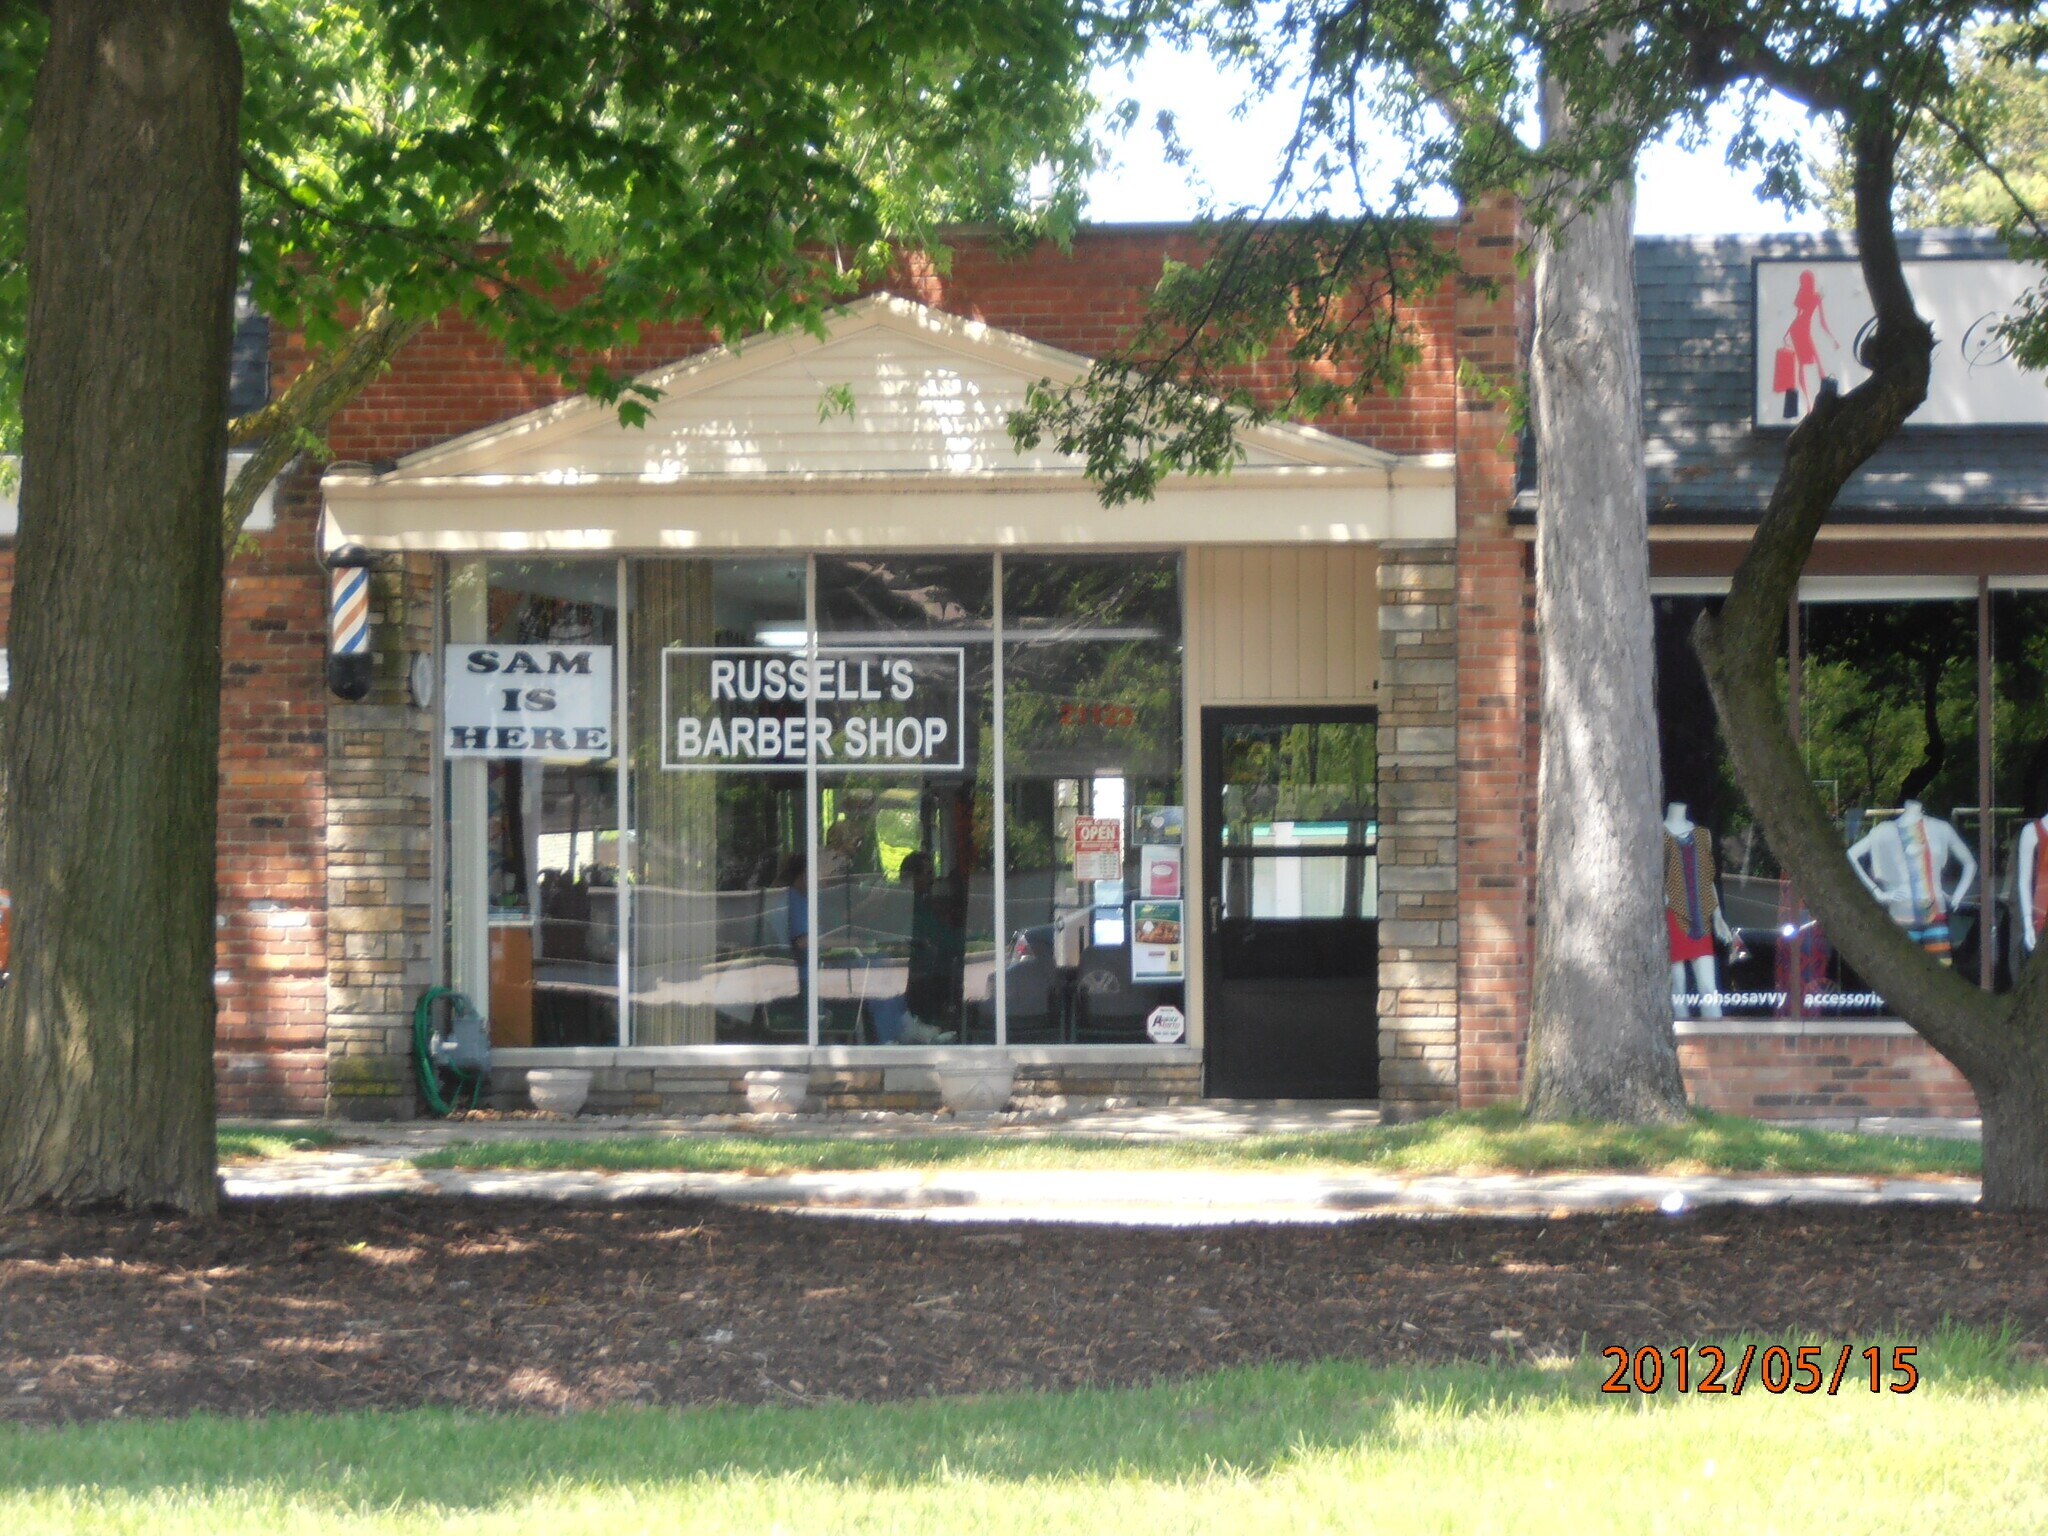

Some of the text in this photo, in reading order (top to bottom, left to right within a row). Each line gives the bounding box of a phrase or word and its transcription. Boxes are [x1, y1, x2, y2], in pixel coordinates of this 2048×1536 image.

[466, 649, 593, 675] SAM
[710, 659, 914, 701] RUSSELL'S
[502, 688, 558, 712] IS
[450, 726, 609, 750] HERE
[677, 715, 948, 758] BARBER SHOP
[1081, 826, 1116, 841] OPEN
[1671, 989, 1787, 1008] ww.ohsosavvy
